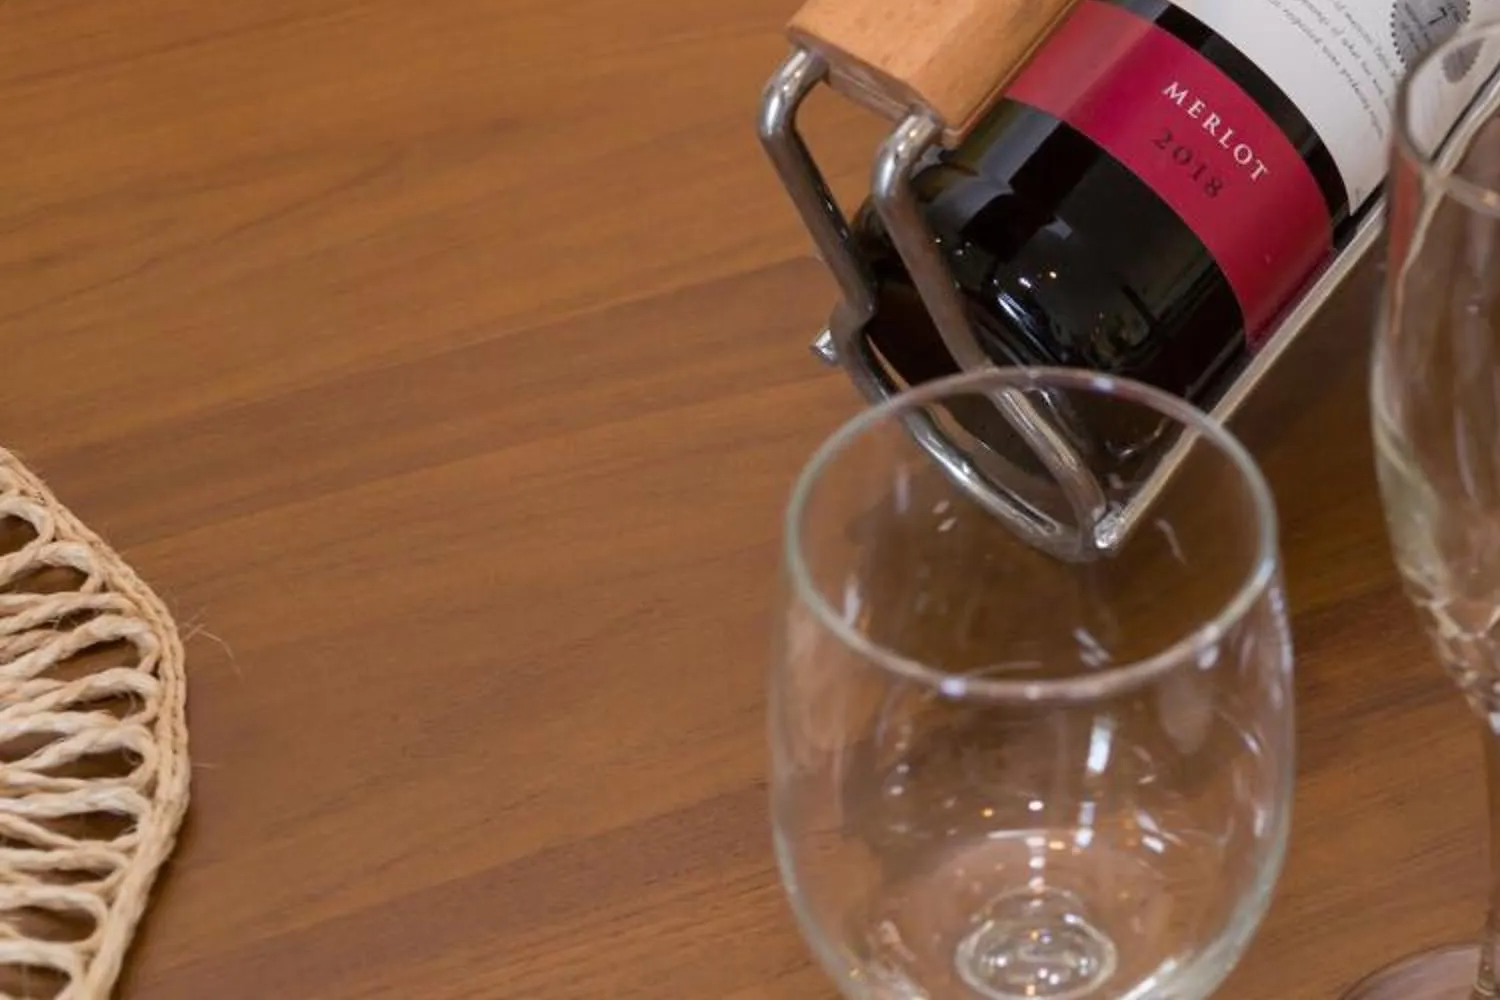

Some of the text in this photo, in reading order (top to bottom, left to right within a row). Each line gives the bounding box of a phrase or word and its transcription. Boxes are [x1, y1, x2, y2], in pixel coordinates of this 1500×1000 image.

[1428, 6, 1447, 26] 7
[1153, 128, 1223, 198] 2018
[1162, 81, 1269, 181] MERLOT
